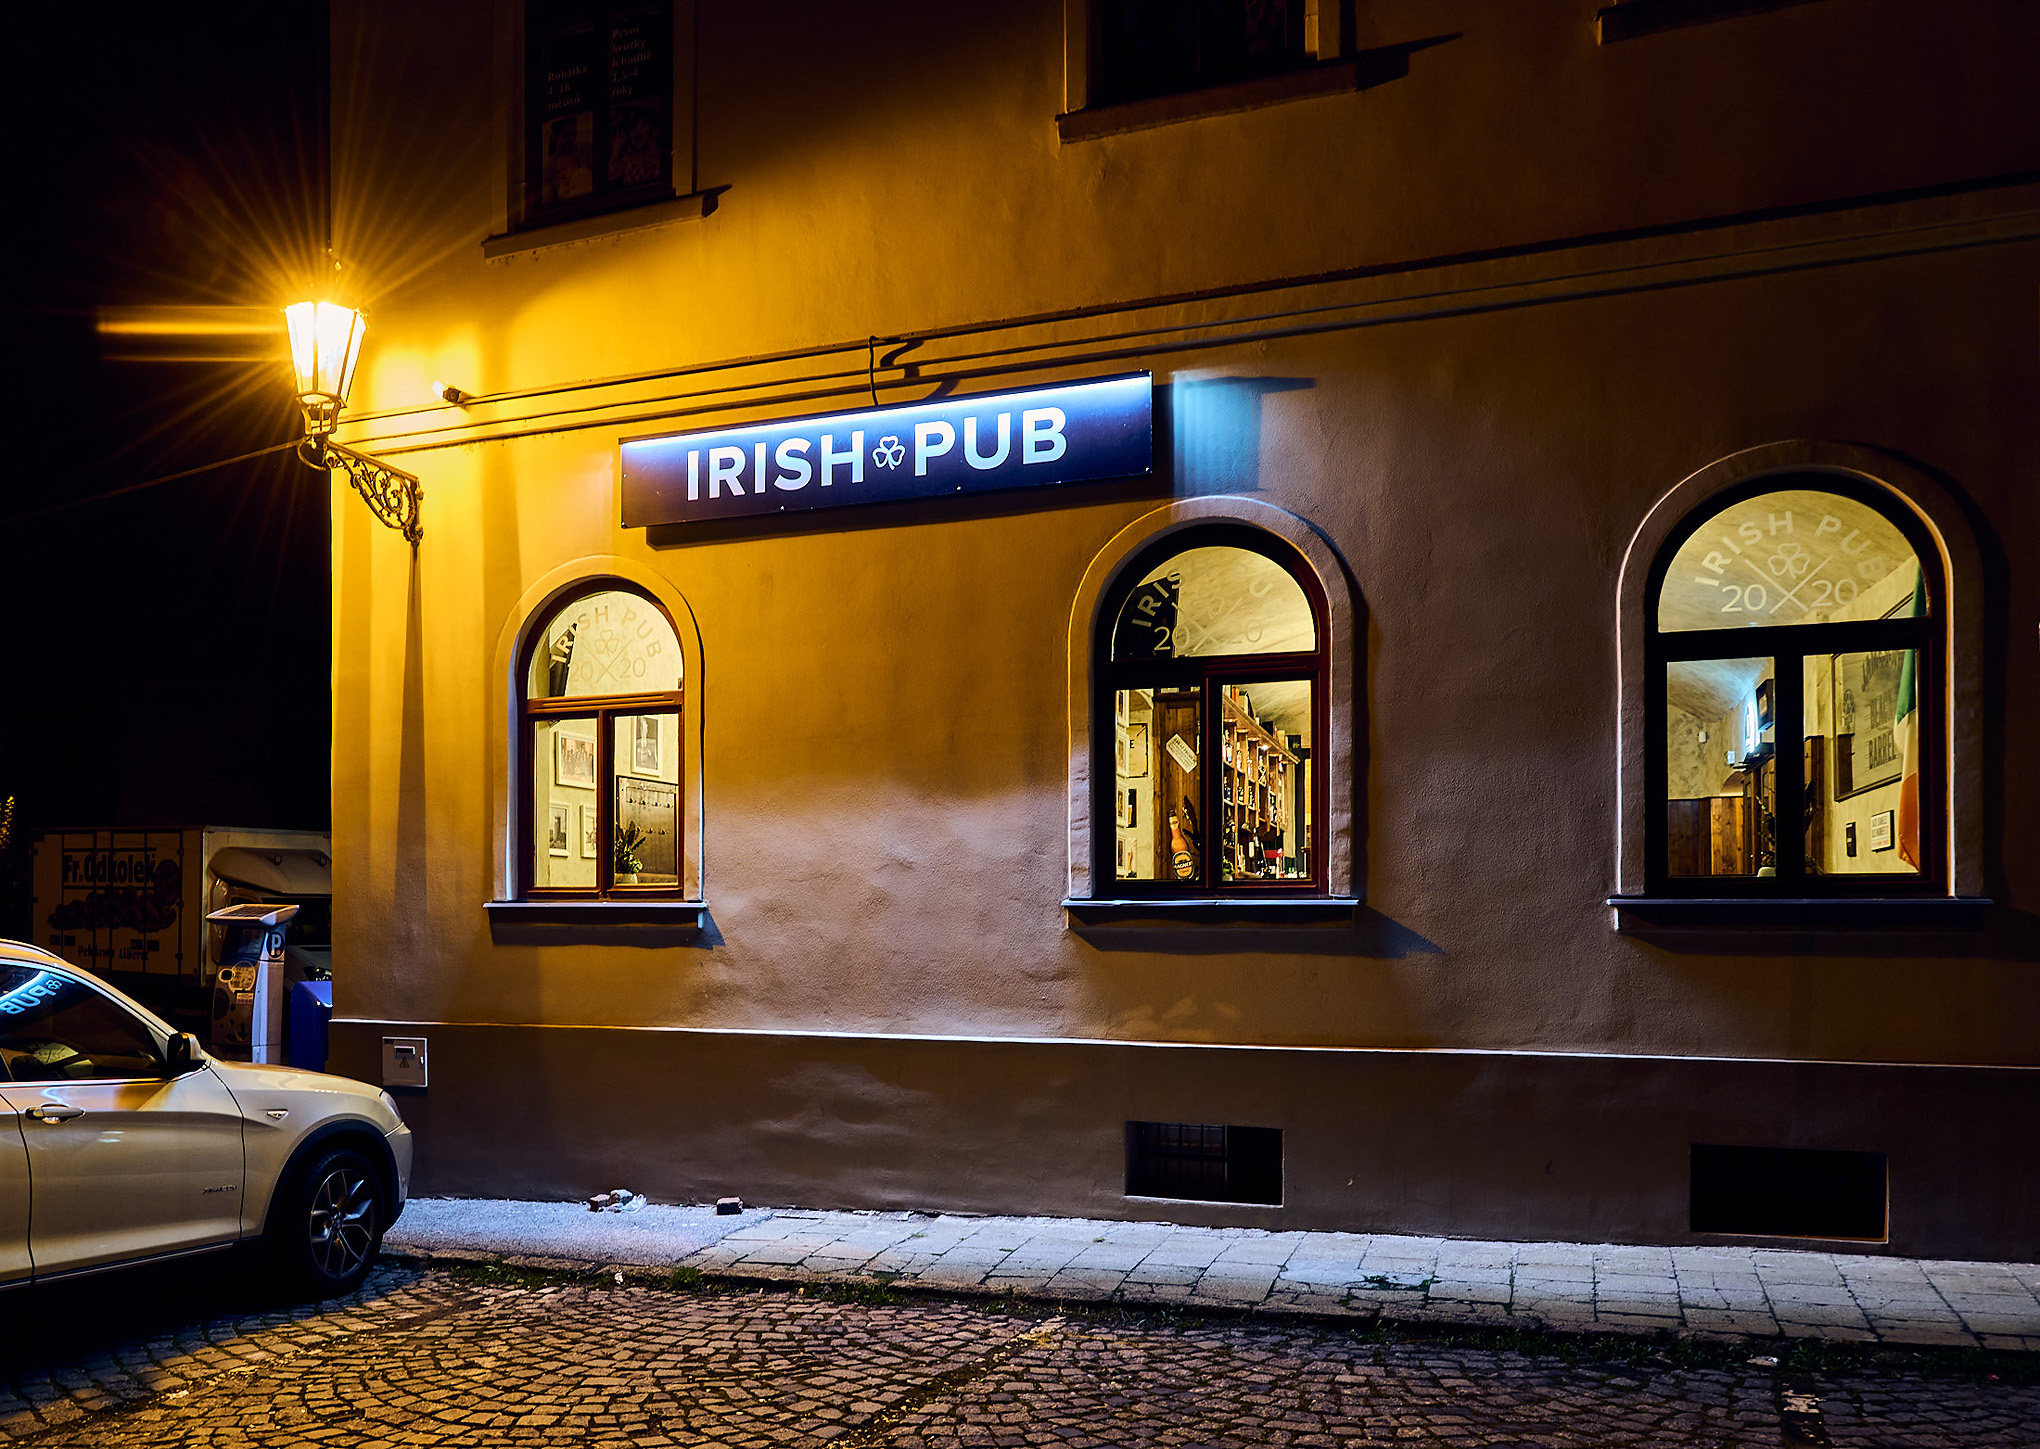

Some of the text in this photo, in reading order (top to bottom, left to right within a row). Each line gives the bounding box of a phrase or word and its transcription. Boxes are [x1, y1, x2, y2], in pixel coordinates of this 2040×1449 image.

[612, 84, 632, 97] roky
[687, 406, 1067, 501] IRISH PUB
[1695, 511, 1886, 587] IRISH PUB
[1132, 566, 1192, 627] IRIS
[1721, 579, 1858, 613] 20 20
[621, 608, 662, 658] PUB
[1154, 626, 1190, 652] 20
[570, 658, 646, 682] 20 20
